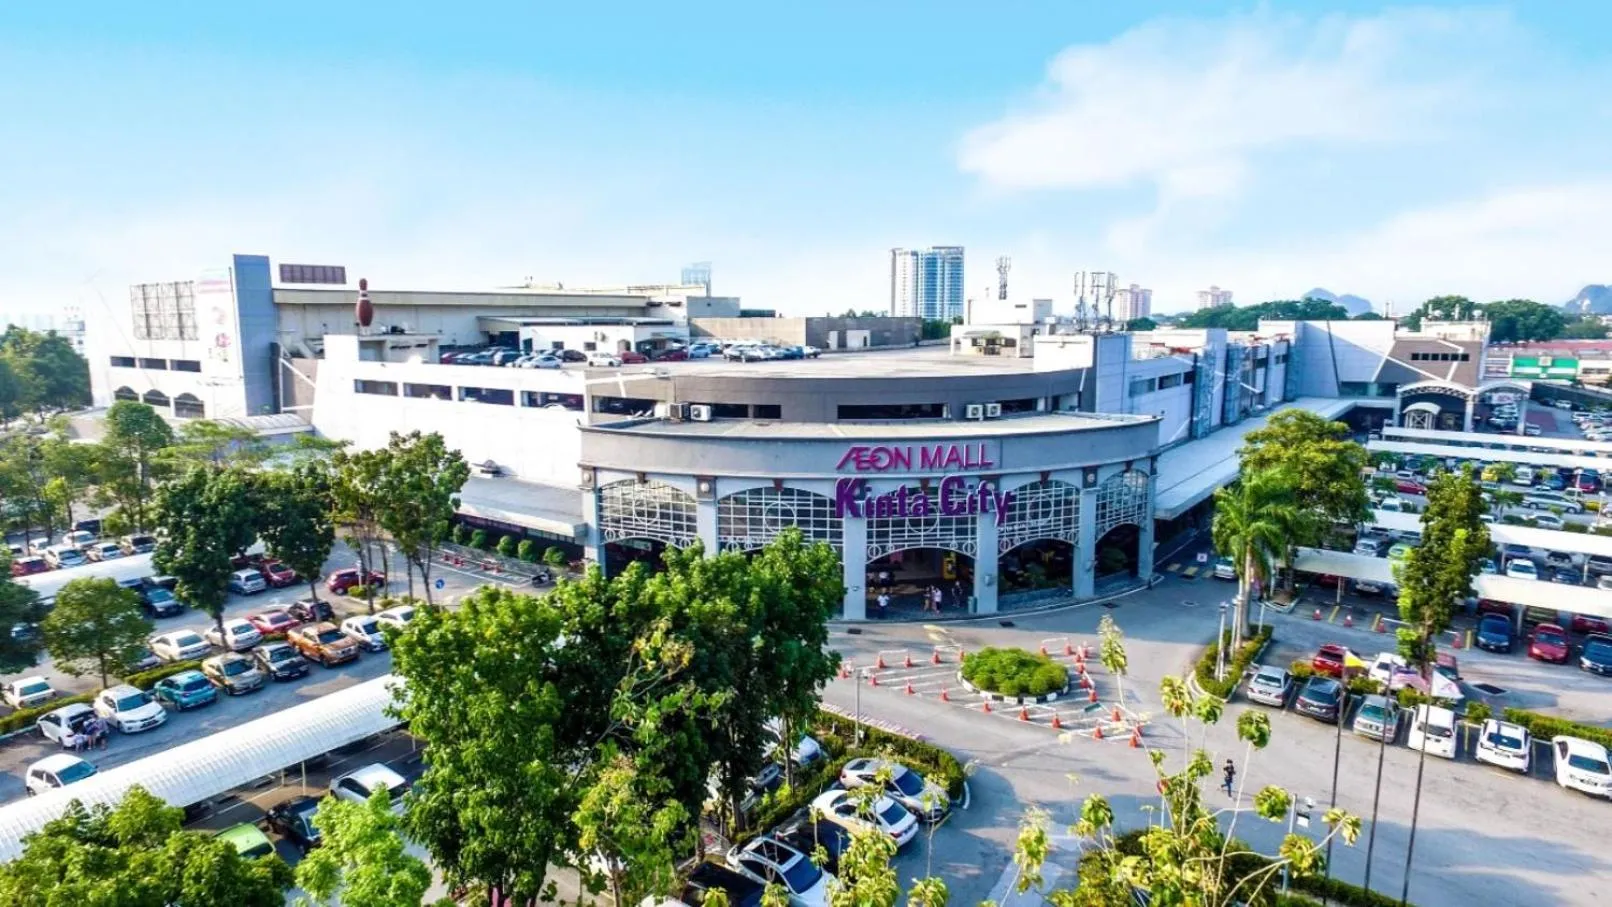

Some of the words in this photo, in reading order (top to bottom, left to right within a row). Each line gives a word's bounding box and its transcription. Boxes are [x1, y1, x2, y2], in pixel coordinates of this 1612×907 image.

[920, 443, 993, 469] MALL
[835, 477, 929, 518] Kinta
[938, 476, 1014, 527] City
